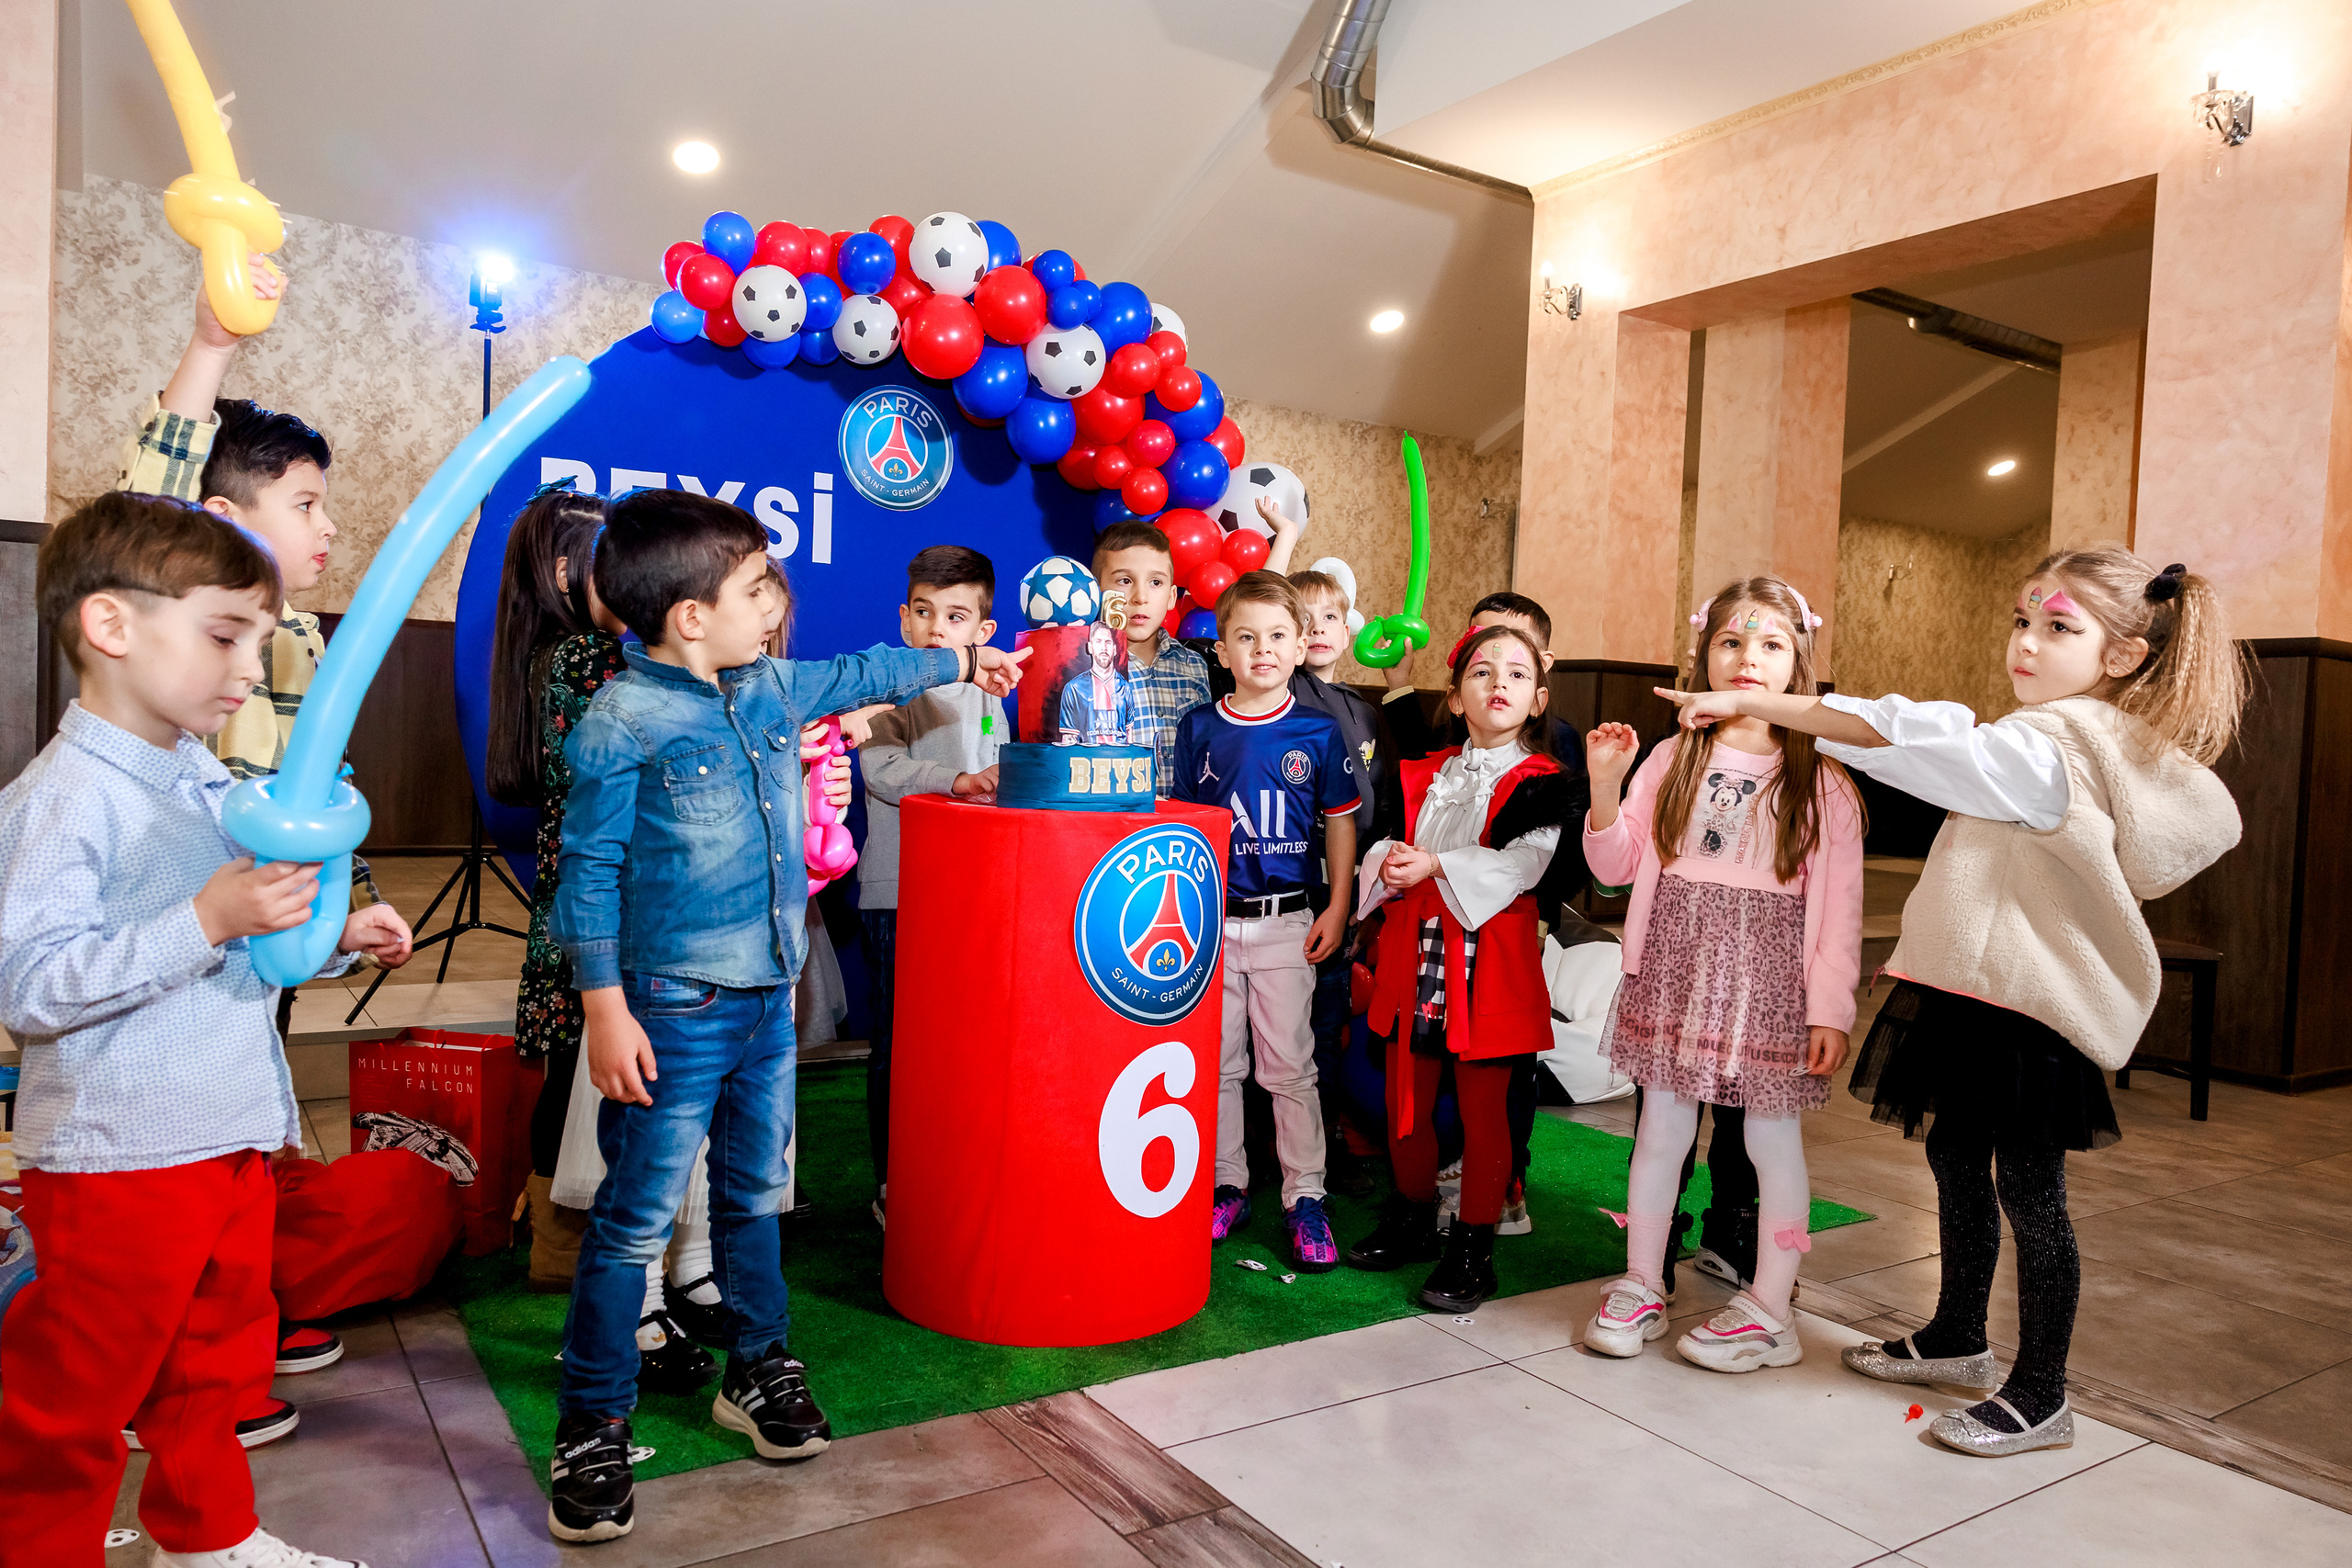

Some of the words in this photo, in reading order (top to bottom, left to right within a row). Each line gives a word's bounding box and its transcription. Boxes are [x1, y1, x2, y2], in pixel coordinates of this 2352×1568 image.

[863, 396, 933, 428] PARIS
[860, 468, 885, 491] SAINT
[891, 478, 930, 497] GERMAIN
[1105, 596, 1127, 630] 6
[1287, 751, 1307, 762] PARIS
[1069, 756, 1152, 795] BEYSI
[1115, 840, 1209, 885] PARIS
[1235, 842, 1261, 856] LIVE
[1262, 840, 1309, 855] LIMITLESS
[1111, 966, 1150, 1000] SAINT
[1159, 963, 1204, 1003] GERMAIN
[358, 1057, 473, 1077] MILLENNIUM
[406, 1077, 473, 1094] FALCON
[1099, 1042, 1200, 1218] 6
[564, 1437, 602, 1459] adidas
